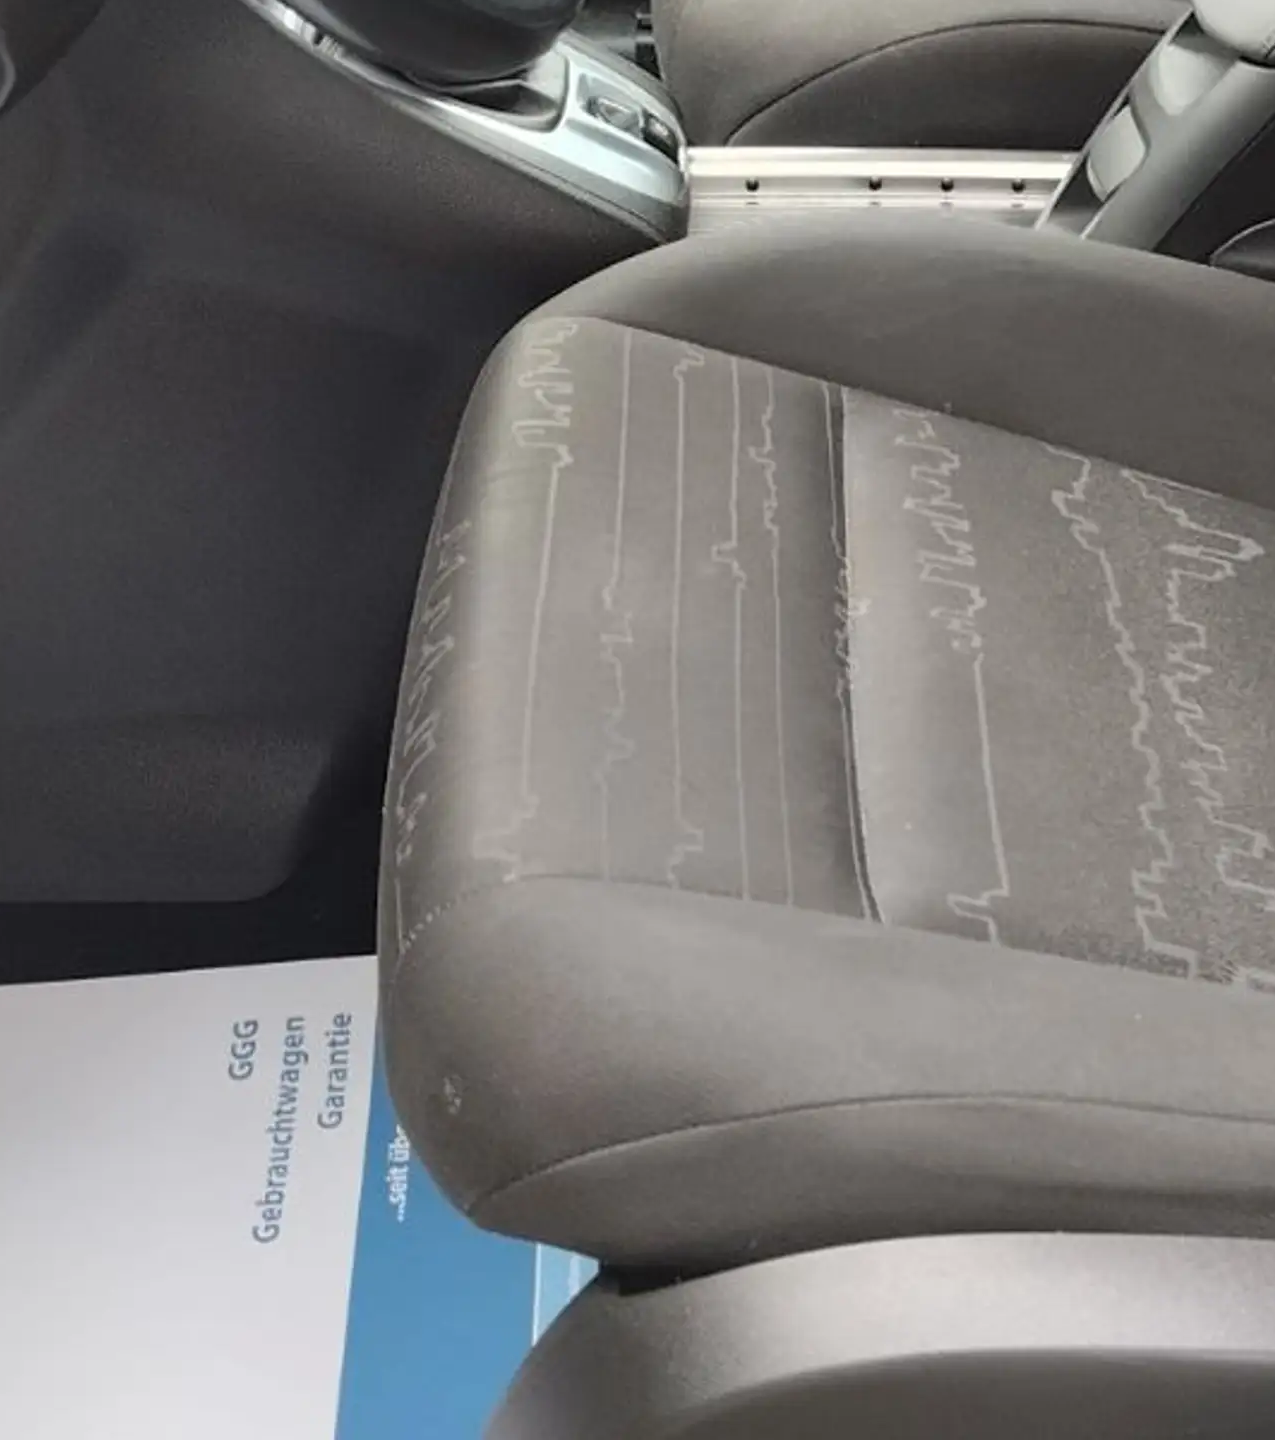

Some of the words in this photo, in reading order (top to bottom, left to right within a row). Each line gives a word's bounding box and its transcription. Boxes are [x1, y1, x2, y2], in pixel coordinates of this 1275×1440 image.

[228, 1019, 259, 1082] GGG
[317, 1012, 353, 1129] Garantie
[252, 1016, 309, 1244] Gebrauchtwagen
